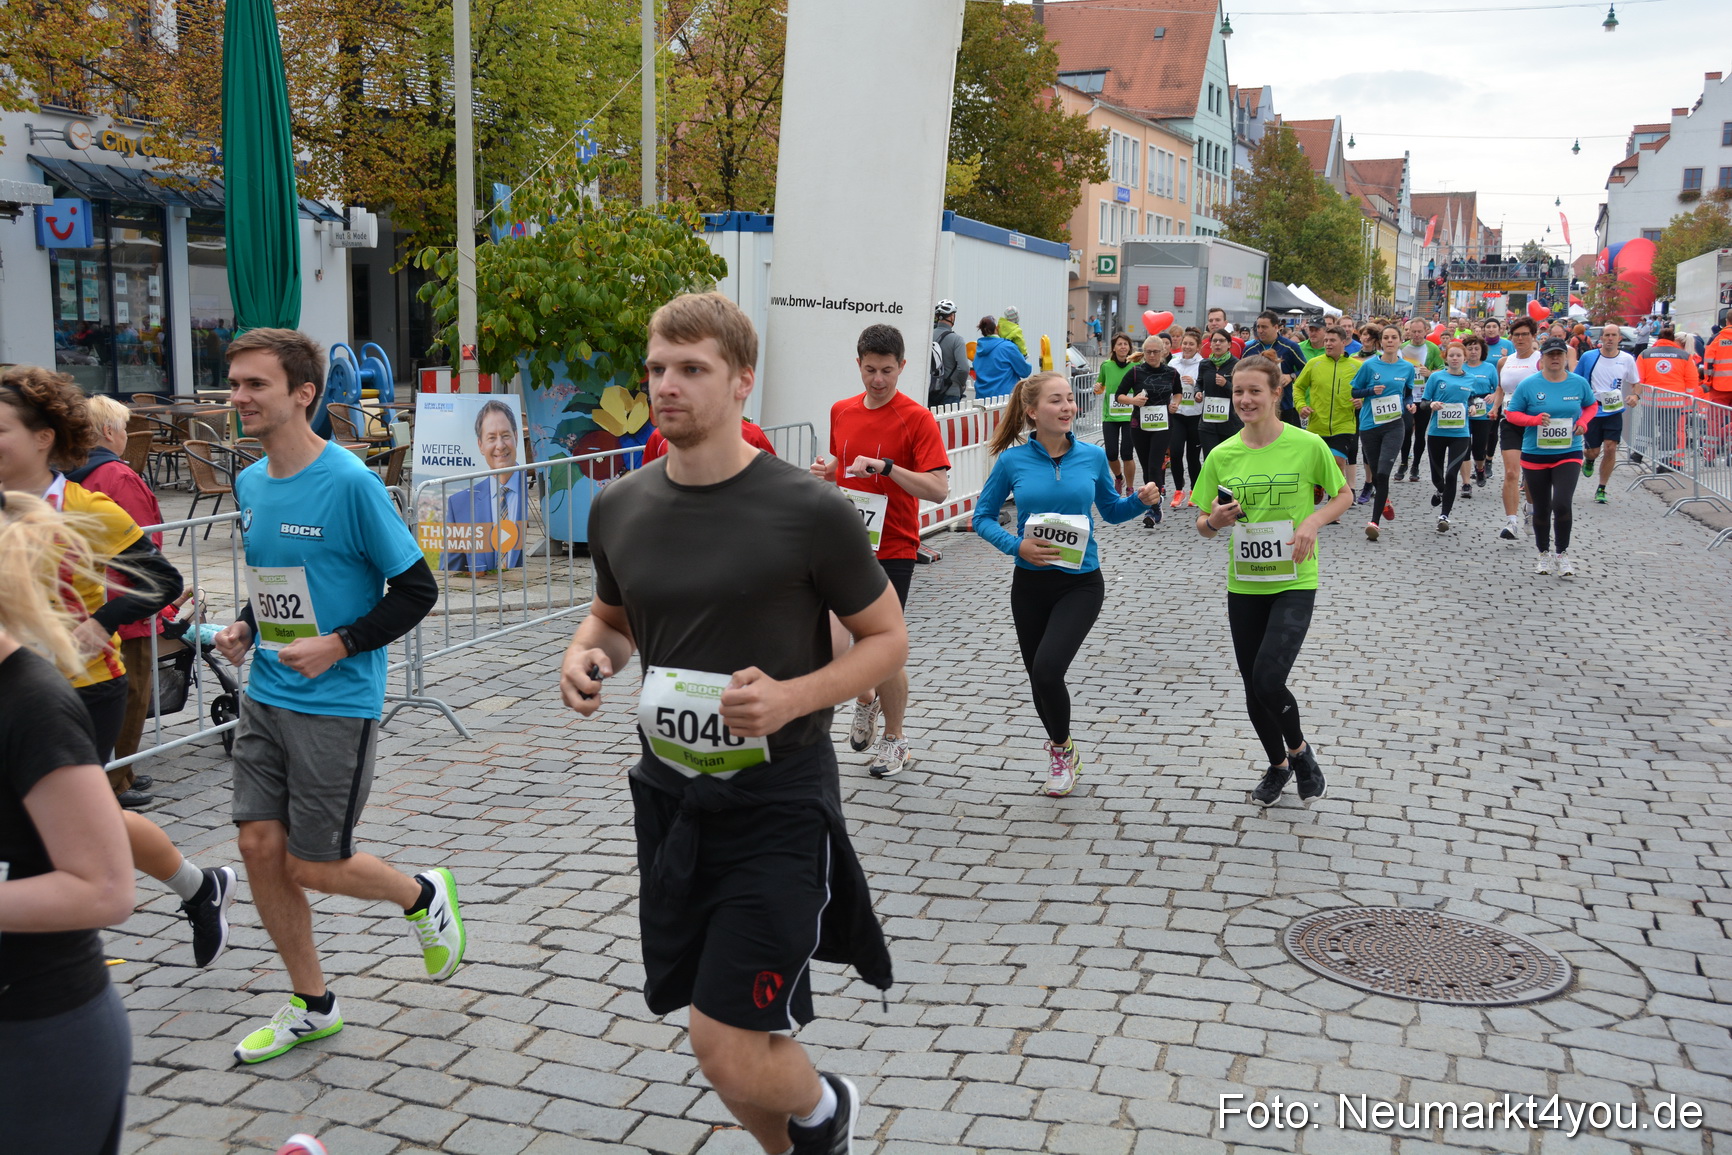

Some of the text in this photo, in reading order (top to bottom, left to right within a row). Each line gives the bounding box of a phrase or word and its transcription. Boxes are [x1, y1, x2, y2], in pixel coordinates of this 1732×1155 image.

[102, 130, 137, 158] City
[1101, 258, 1114, 271] D
[771, 294, 903, 314] www.bmw-laufsport.de
[1206, 405, 1225, 413] 5110
[1376, 403, 1397, 414] 5119
[1144, 413, 1164, 421] 5052
[1542, 428, 1567, 437] 5068
[422, 444, 463, 454] WEITER.
[422, 456, 475, 466] MACHEN.
[280, 524, 322, 537] BOCK
[421, 526, 484, 538] THOMAS
[1033, 526, 1078, 545] 5086
[421, 539, 484, 550] THUMANN
[1241, 540, 1282, 558] 5081
[258, 593, 304, 619] 5032
[274, 628, 295, 637] Stefan
[684, 751, 724, 767] Florian
